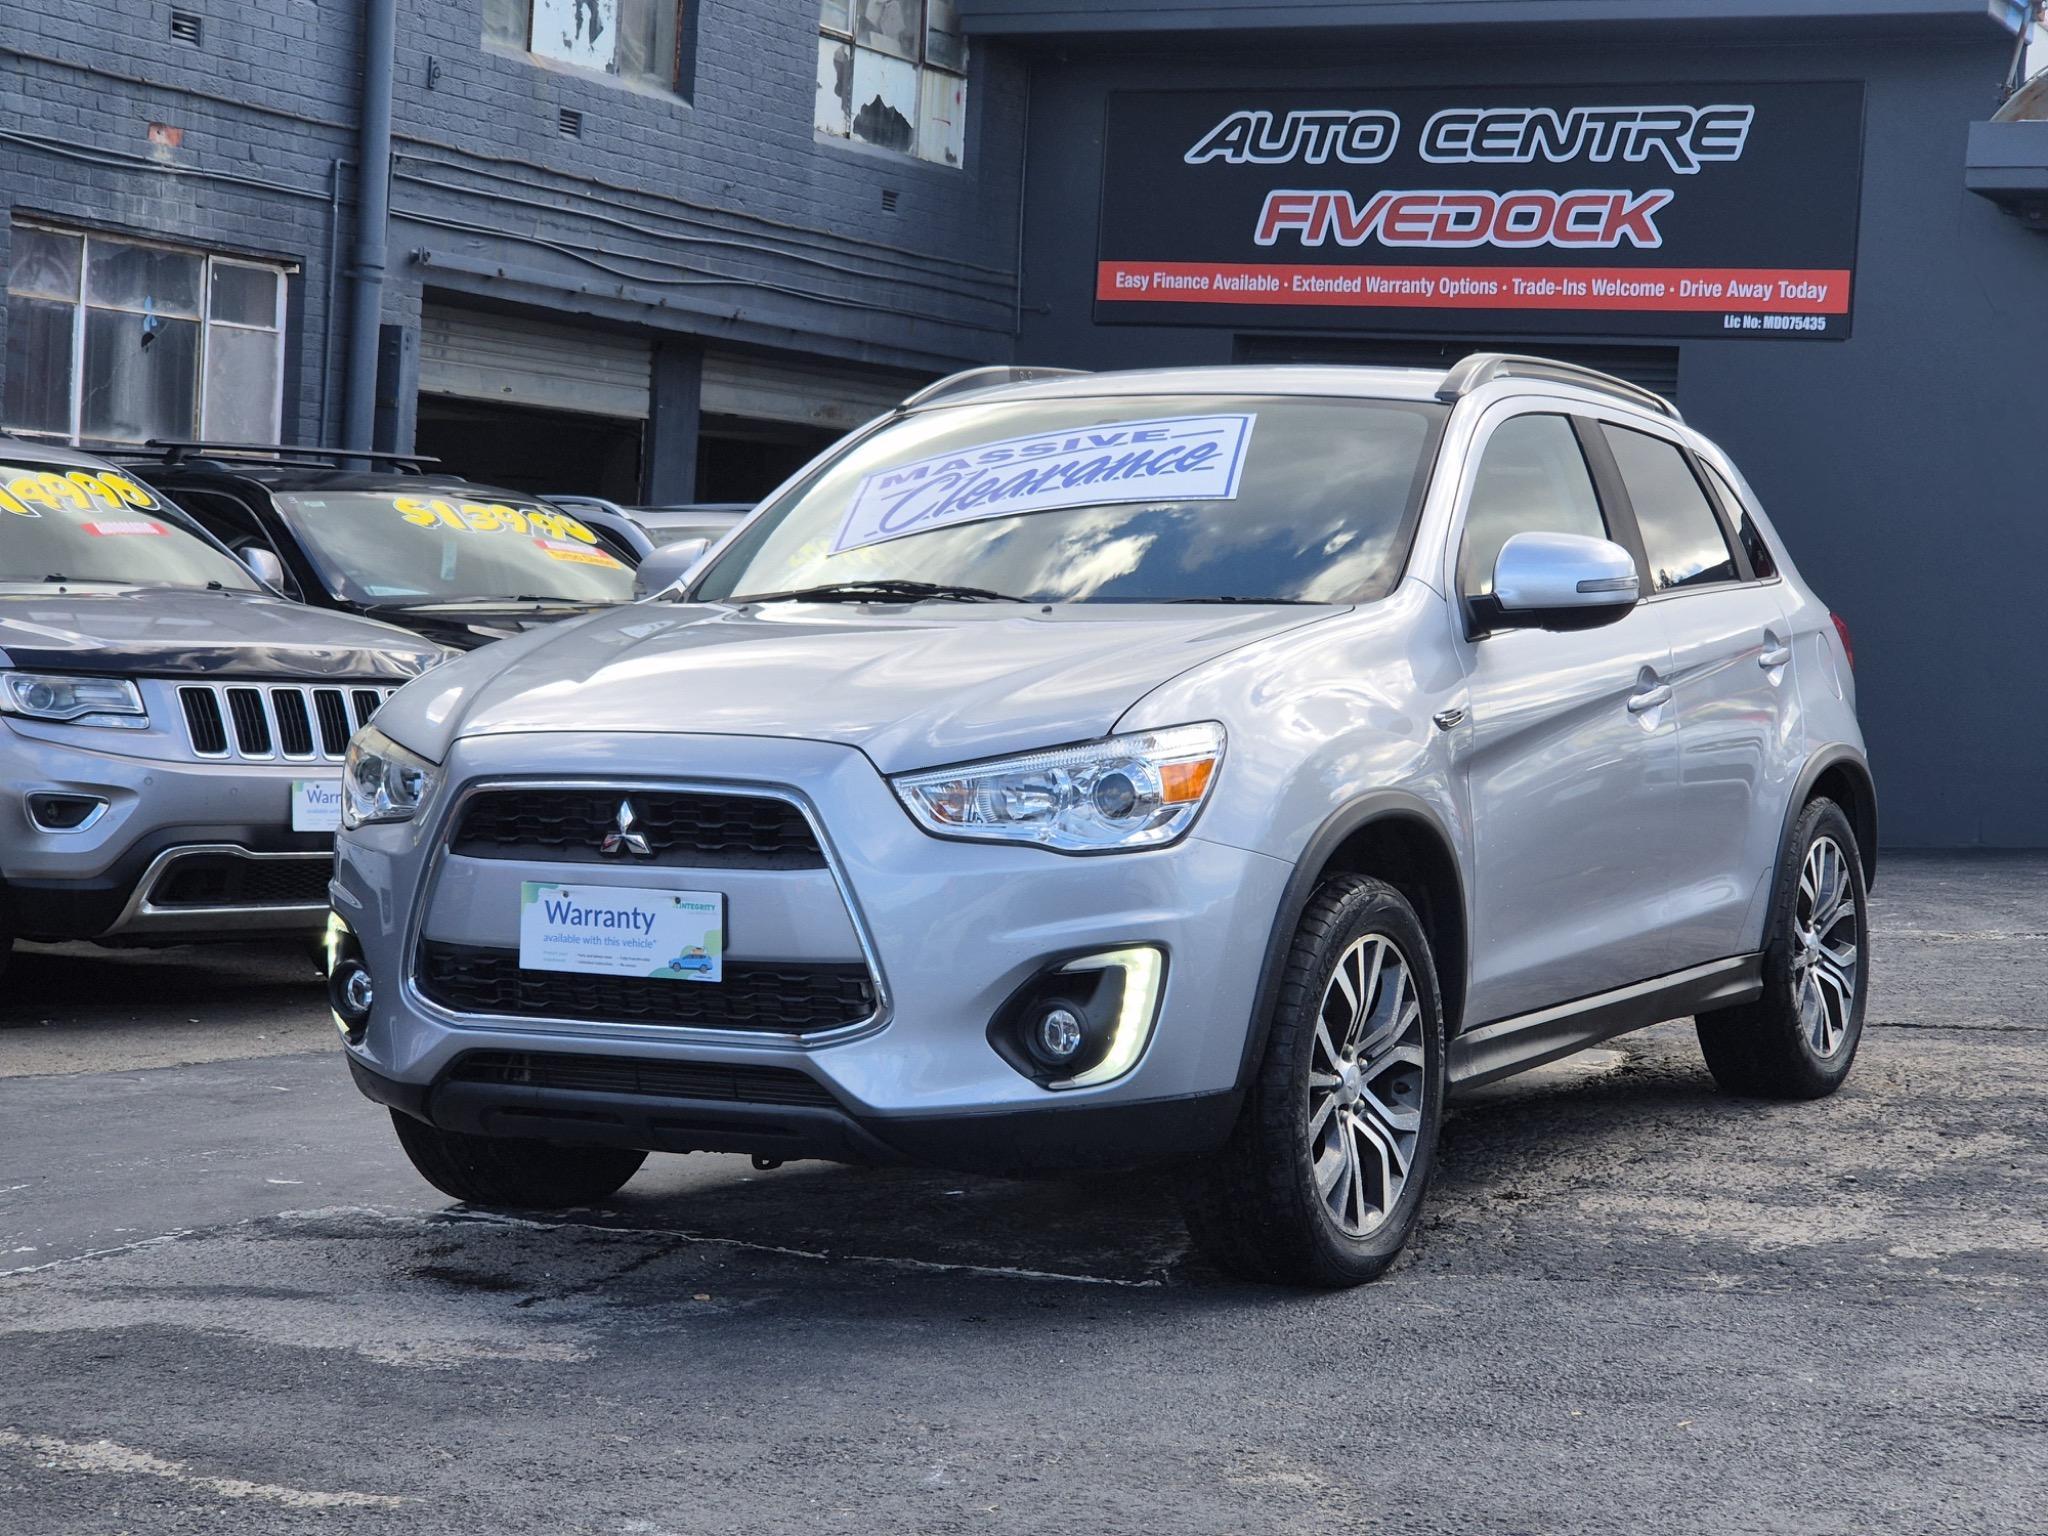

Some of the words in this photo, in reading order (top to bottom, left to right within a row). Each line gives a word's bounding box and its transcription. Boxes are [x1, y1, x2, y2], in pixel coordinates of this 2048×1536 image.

[1184, 109, 1400, 165] AUTO
[1419, 104, 1755, 174] CENTRE
[1253, 188, 1674, 249] FIVEDOCK
[1115, 271, 1149, 291] Easy
[1153, 271, 1209, 290] Finance
[1212, 273, 1280, 291] Available
[1292, 275, 1362, 293] Extended
[1366, 276, 1435, 297] Warranty
[1439, 277, 1498, 298] Options
[1512, 278, 1587, 296] Trade-Ins
[1591, 278, 1666, 297] Welcome
[1679, 279, 1722, 298] Drive
[1726, 280, 1773, 301] Away
[1778, 280, 1828, 302] Today
[1723, 314, 1741, 329] Lic
[1743, 314, 1762, 329] No:
[1763, 315, 1826, 331] MD075435
[879, 428, 1170, 490] MASSIVE
[878, 442, 1219, 534] Clearance
[543, 934, 580, 944] available
[582, 936, 601, 946] with
[603, 937, 620, 947] this
[545, 900, 656, 935] Warranty
